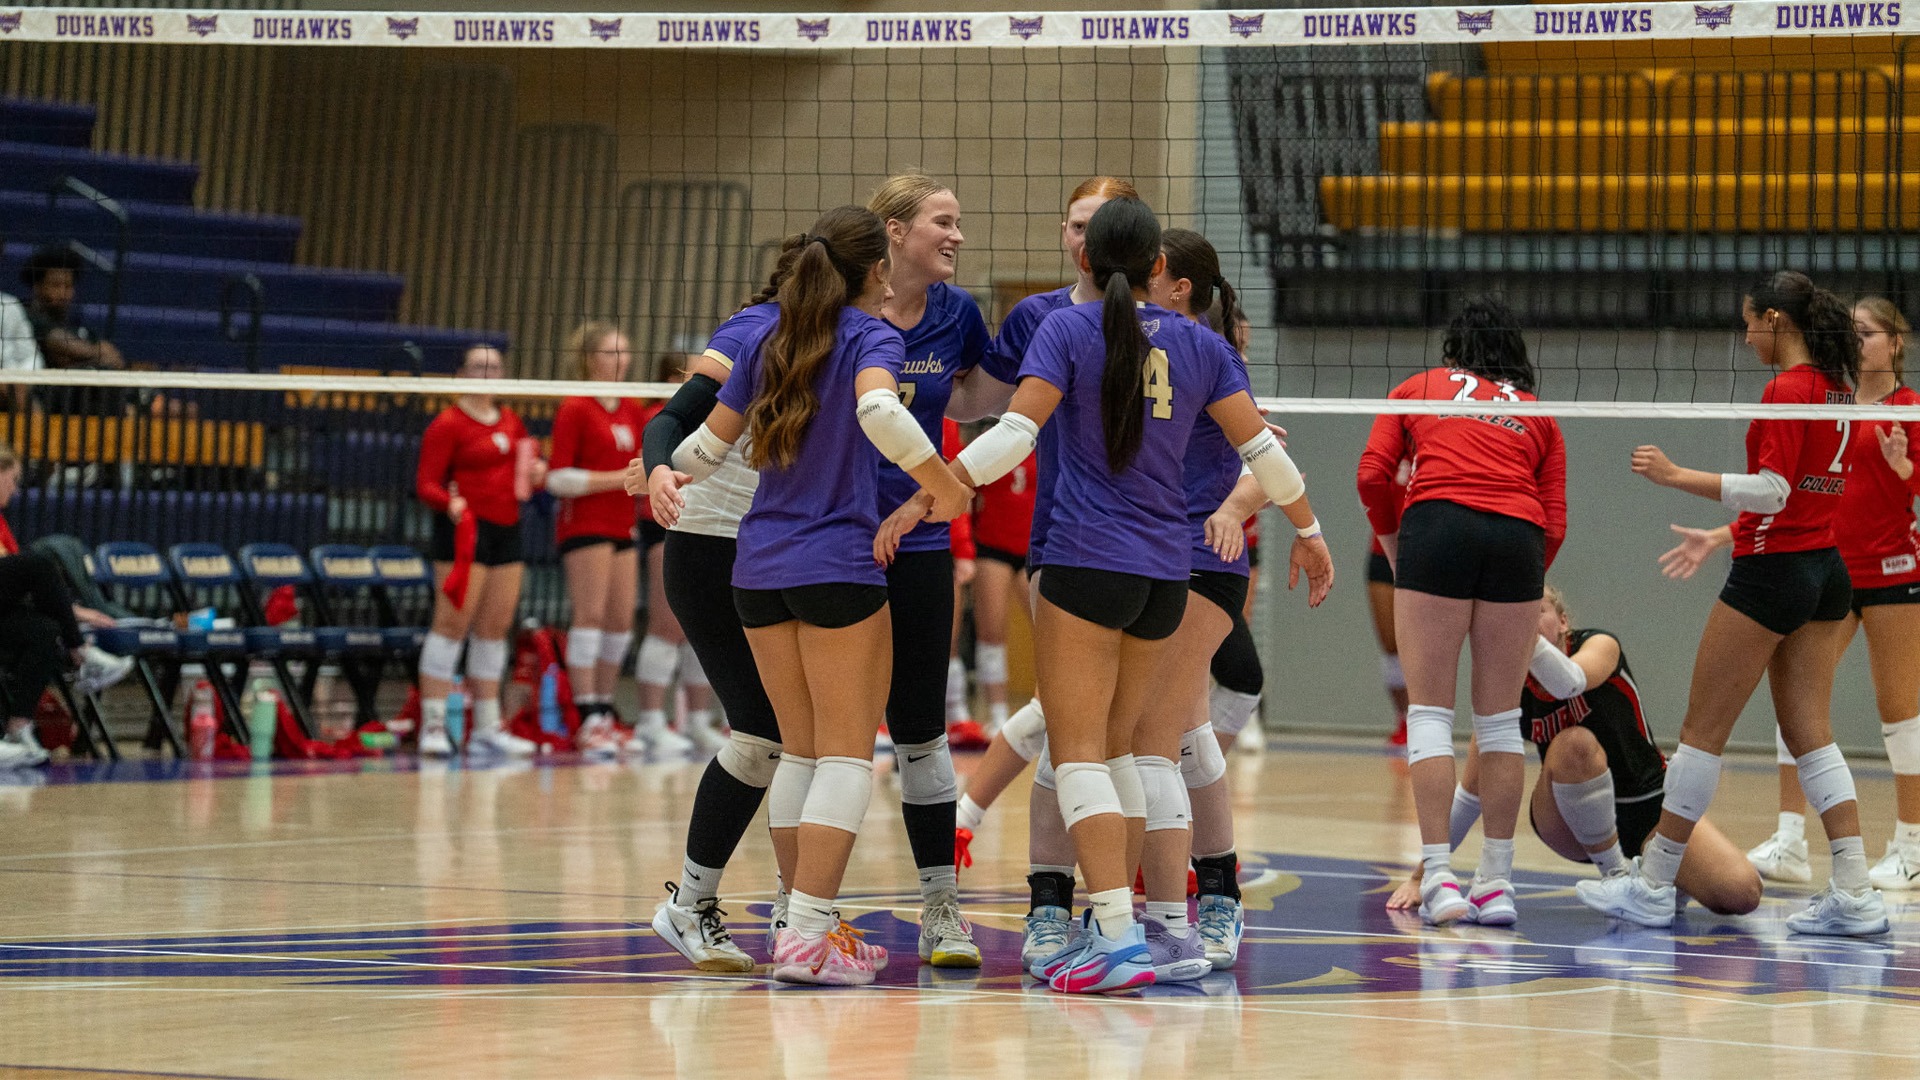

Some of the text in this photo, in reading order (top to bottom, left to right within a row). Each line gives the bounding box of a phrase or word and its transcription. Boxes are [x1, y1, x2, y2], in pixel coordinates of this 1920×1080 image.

[56, 15, 154, 36] DUHAWKS
[1303, 13, 1417, 37] DUHAWKS
[1534, 9, 1653, 34] DUHAWKS
[1776, 2, 1901, 29] DUHAWKS
[252, 18, 352, 39] DUHAWKS
[453, 20, 555, 41] DUHAWKS
[657, 20, 761, 42] DUHAWKS
[866, 19, 972, 41] DUHAWKS
[1081, 17, 1190, 40] DUHAWKS
[900, 351, 945, 374] awks
[1142, 347, 1173, 420] 4
[1449, 372, 1521, 401] 23
[697, 444, 722, 467] Tande
